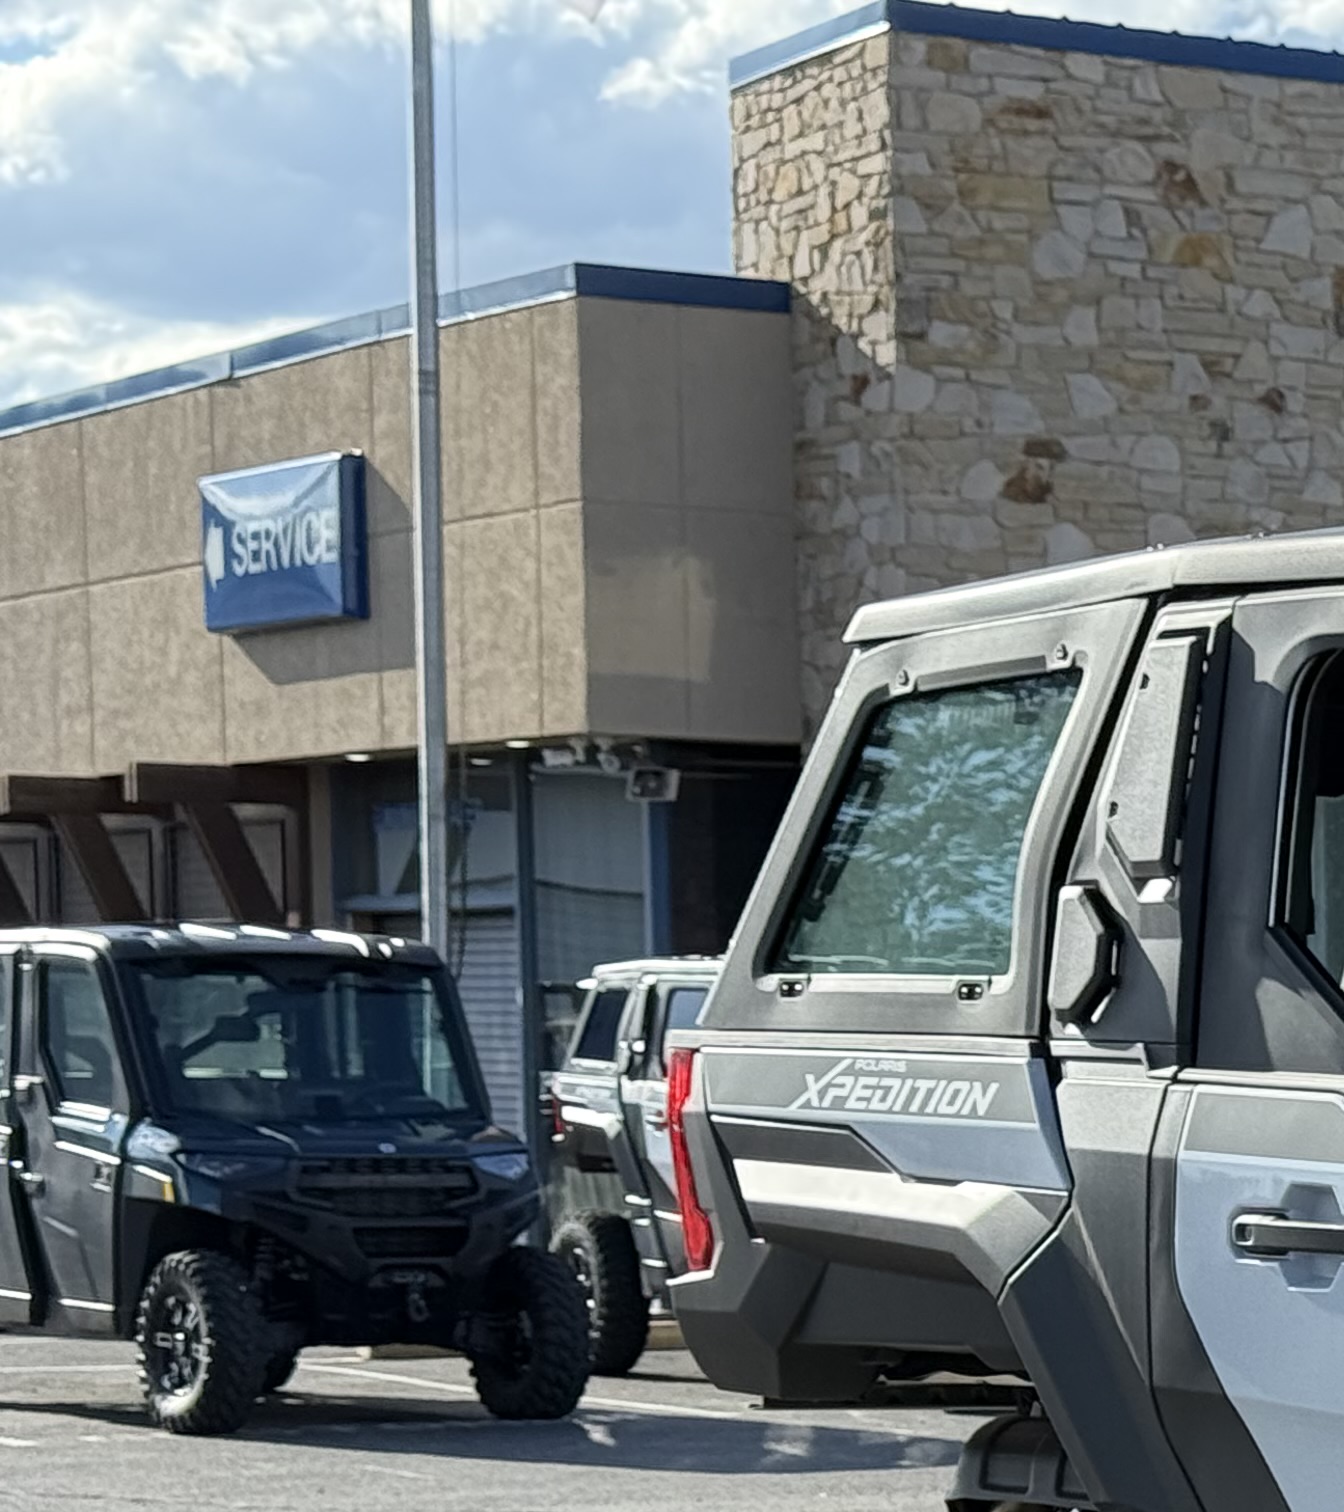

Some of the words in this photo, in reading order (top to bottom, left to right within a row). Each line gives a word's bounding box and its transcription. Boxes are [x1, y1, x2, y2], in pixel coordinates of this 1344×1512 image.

[231, 508, 340, 577] SERVICE
[787, 1057, 1000, 1117] XPEDITION
[854, 1058, 907, 1074] POLARIS
